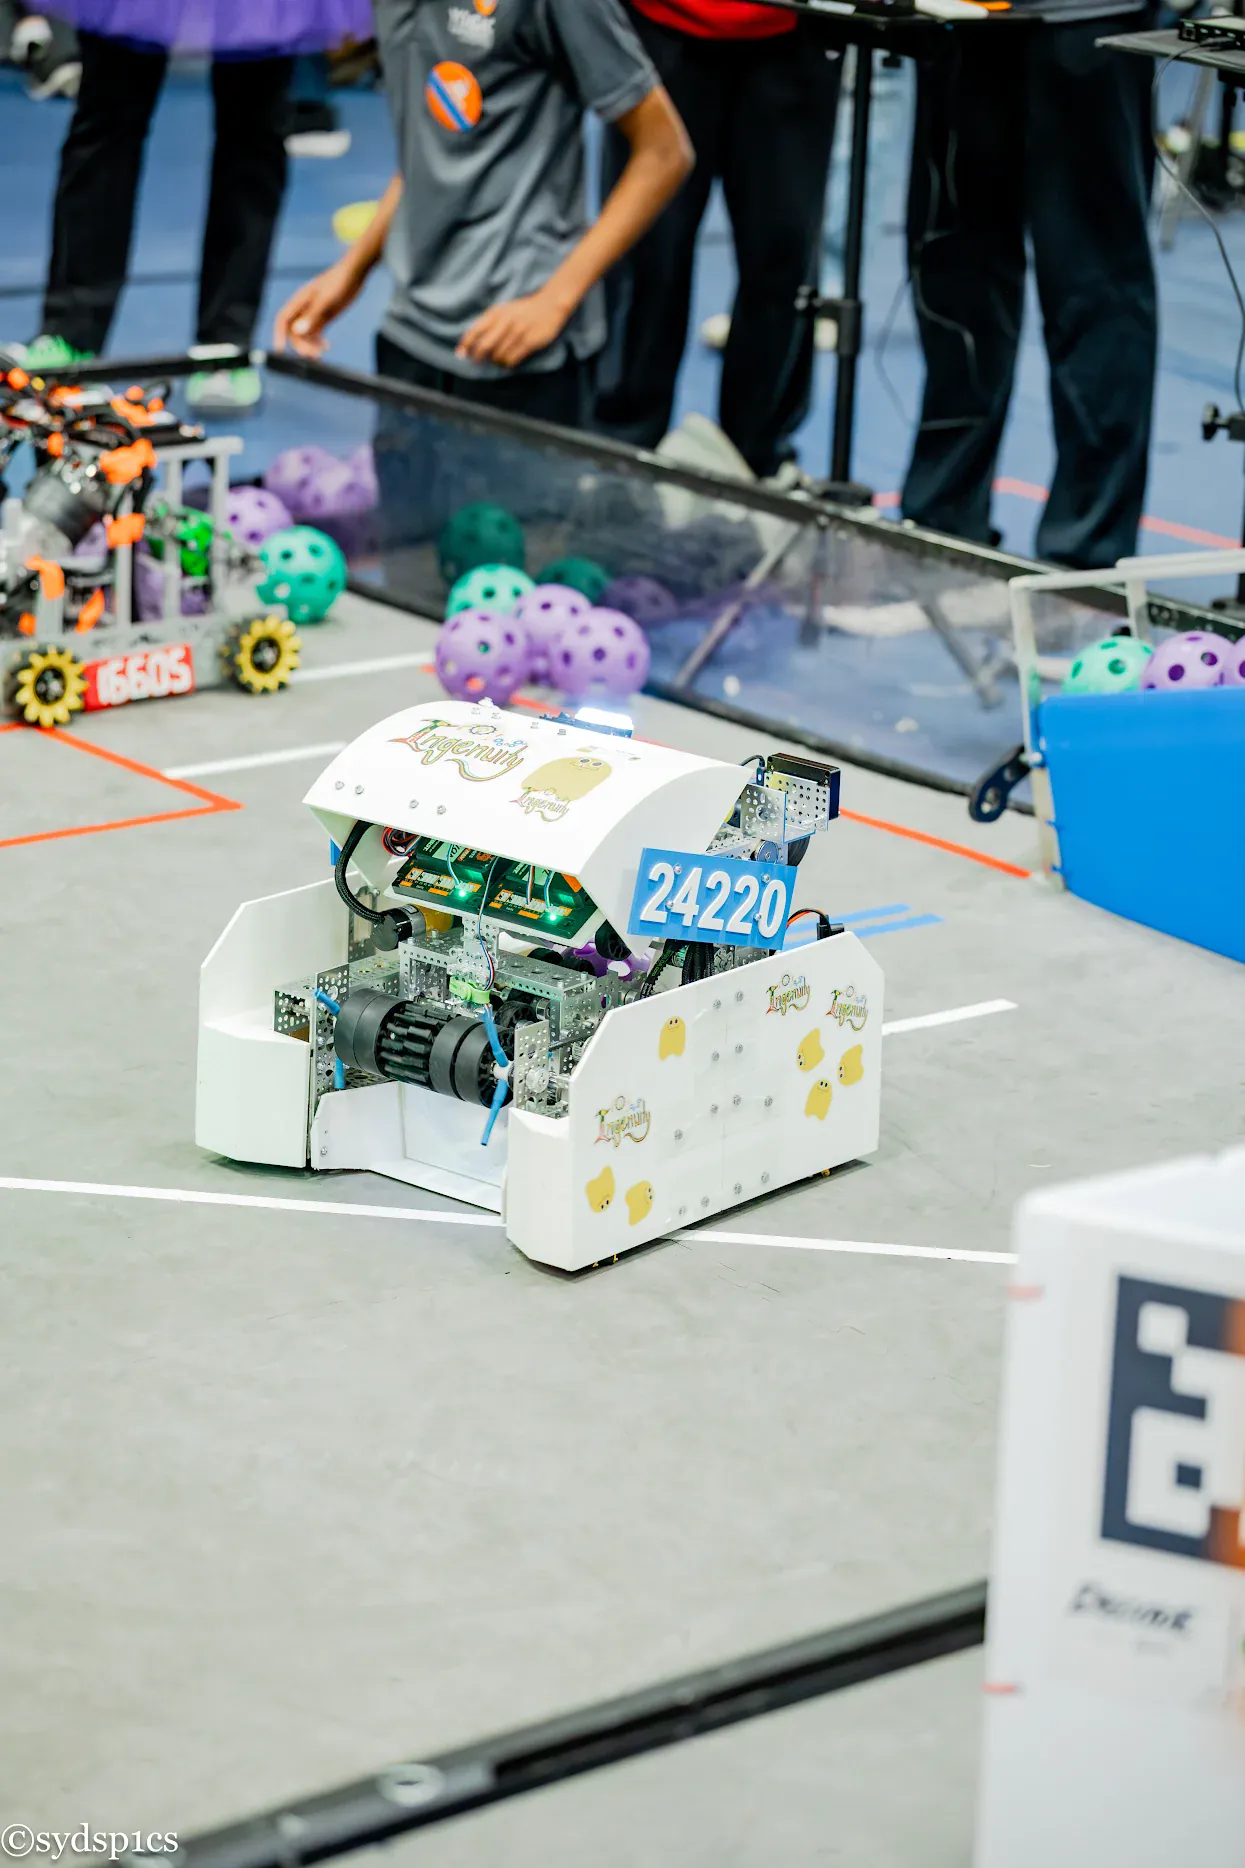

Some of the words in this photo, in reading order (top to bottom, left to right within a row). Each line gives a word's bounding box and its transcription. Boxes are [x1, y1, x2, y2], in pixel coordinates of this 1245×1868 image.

[387, 719, 528, 782] Ingenuity
[509, 786, 570, 822] Ingenuity
[640, 862, 787, 938] 24220
[766, 976, 810, 1016] Ingenuity
[826, 989, 868, 1031] Ingenuity
[594, 1099, 651, 1147] Ingenuity
